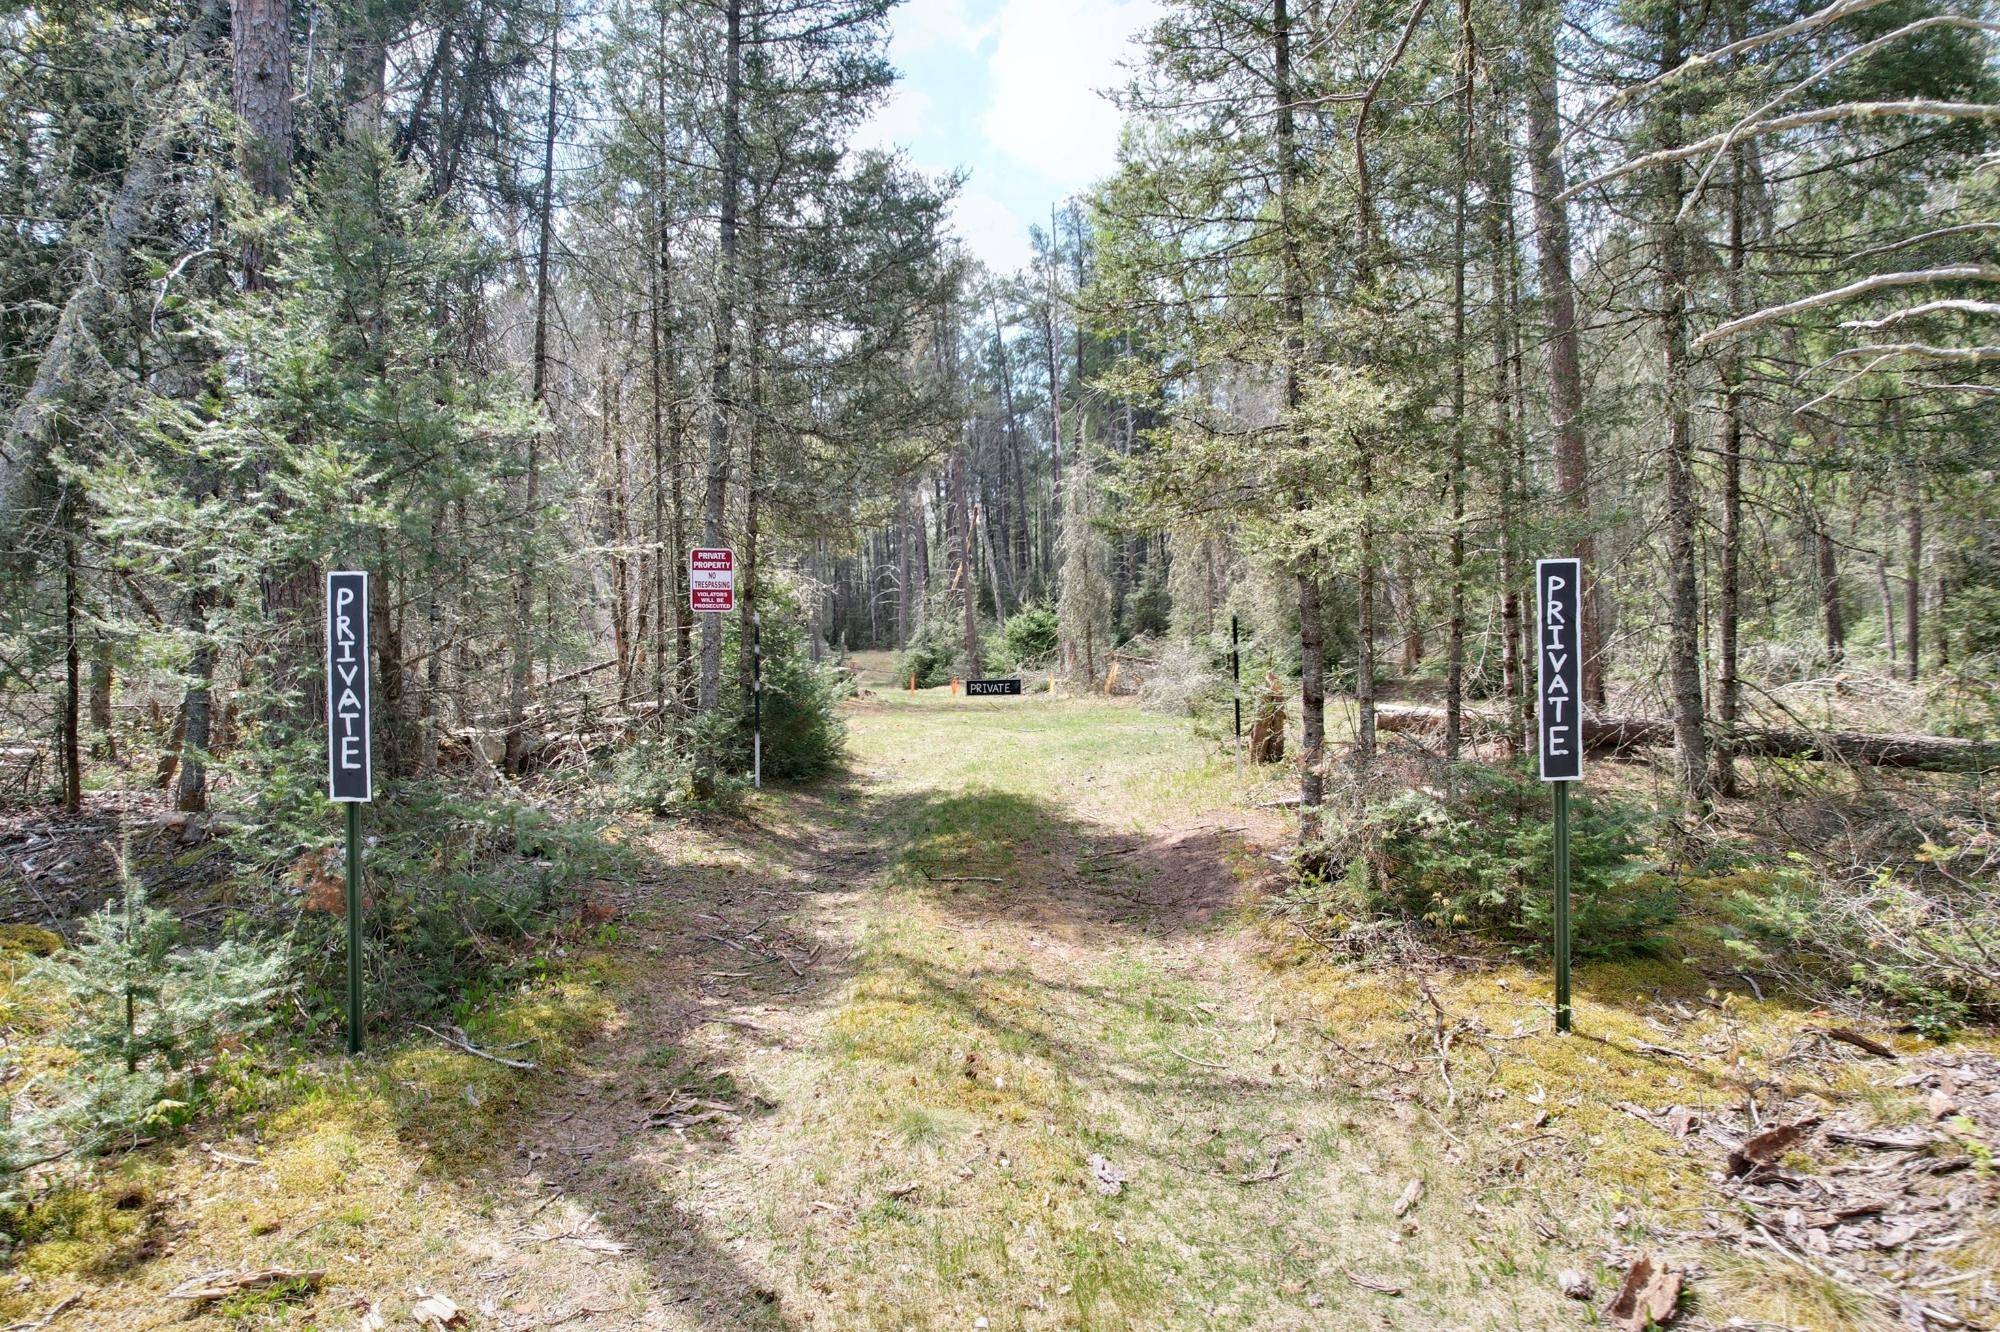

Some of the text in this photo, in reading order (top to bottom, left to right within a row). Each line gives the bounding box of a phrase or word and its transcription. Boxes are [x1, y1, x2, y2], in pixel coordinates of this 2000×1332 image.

[698, 552, 726, 560] PRIVATE
[693, 561, 731, 569] PROPERTY
[694, 581, 731, 589] TRESPASSING
[1546, 575, 1569, 756] PRIVATE
[336, 587, 362, 769] PRIVATE
[970, 683, 1011, 694] PRIVATE
